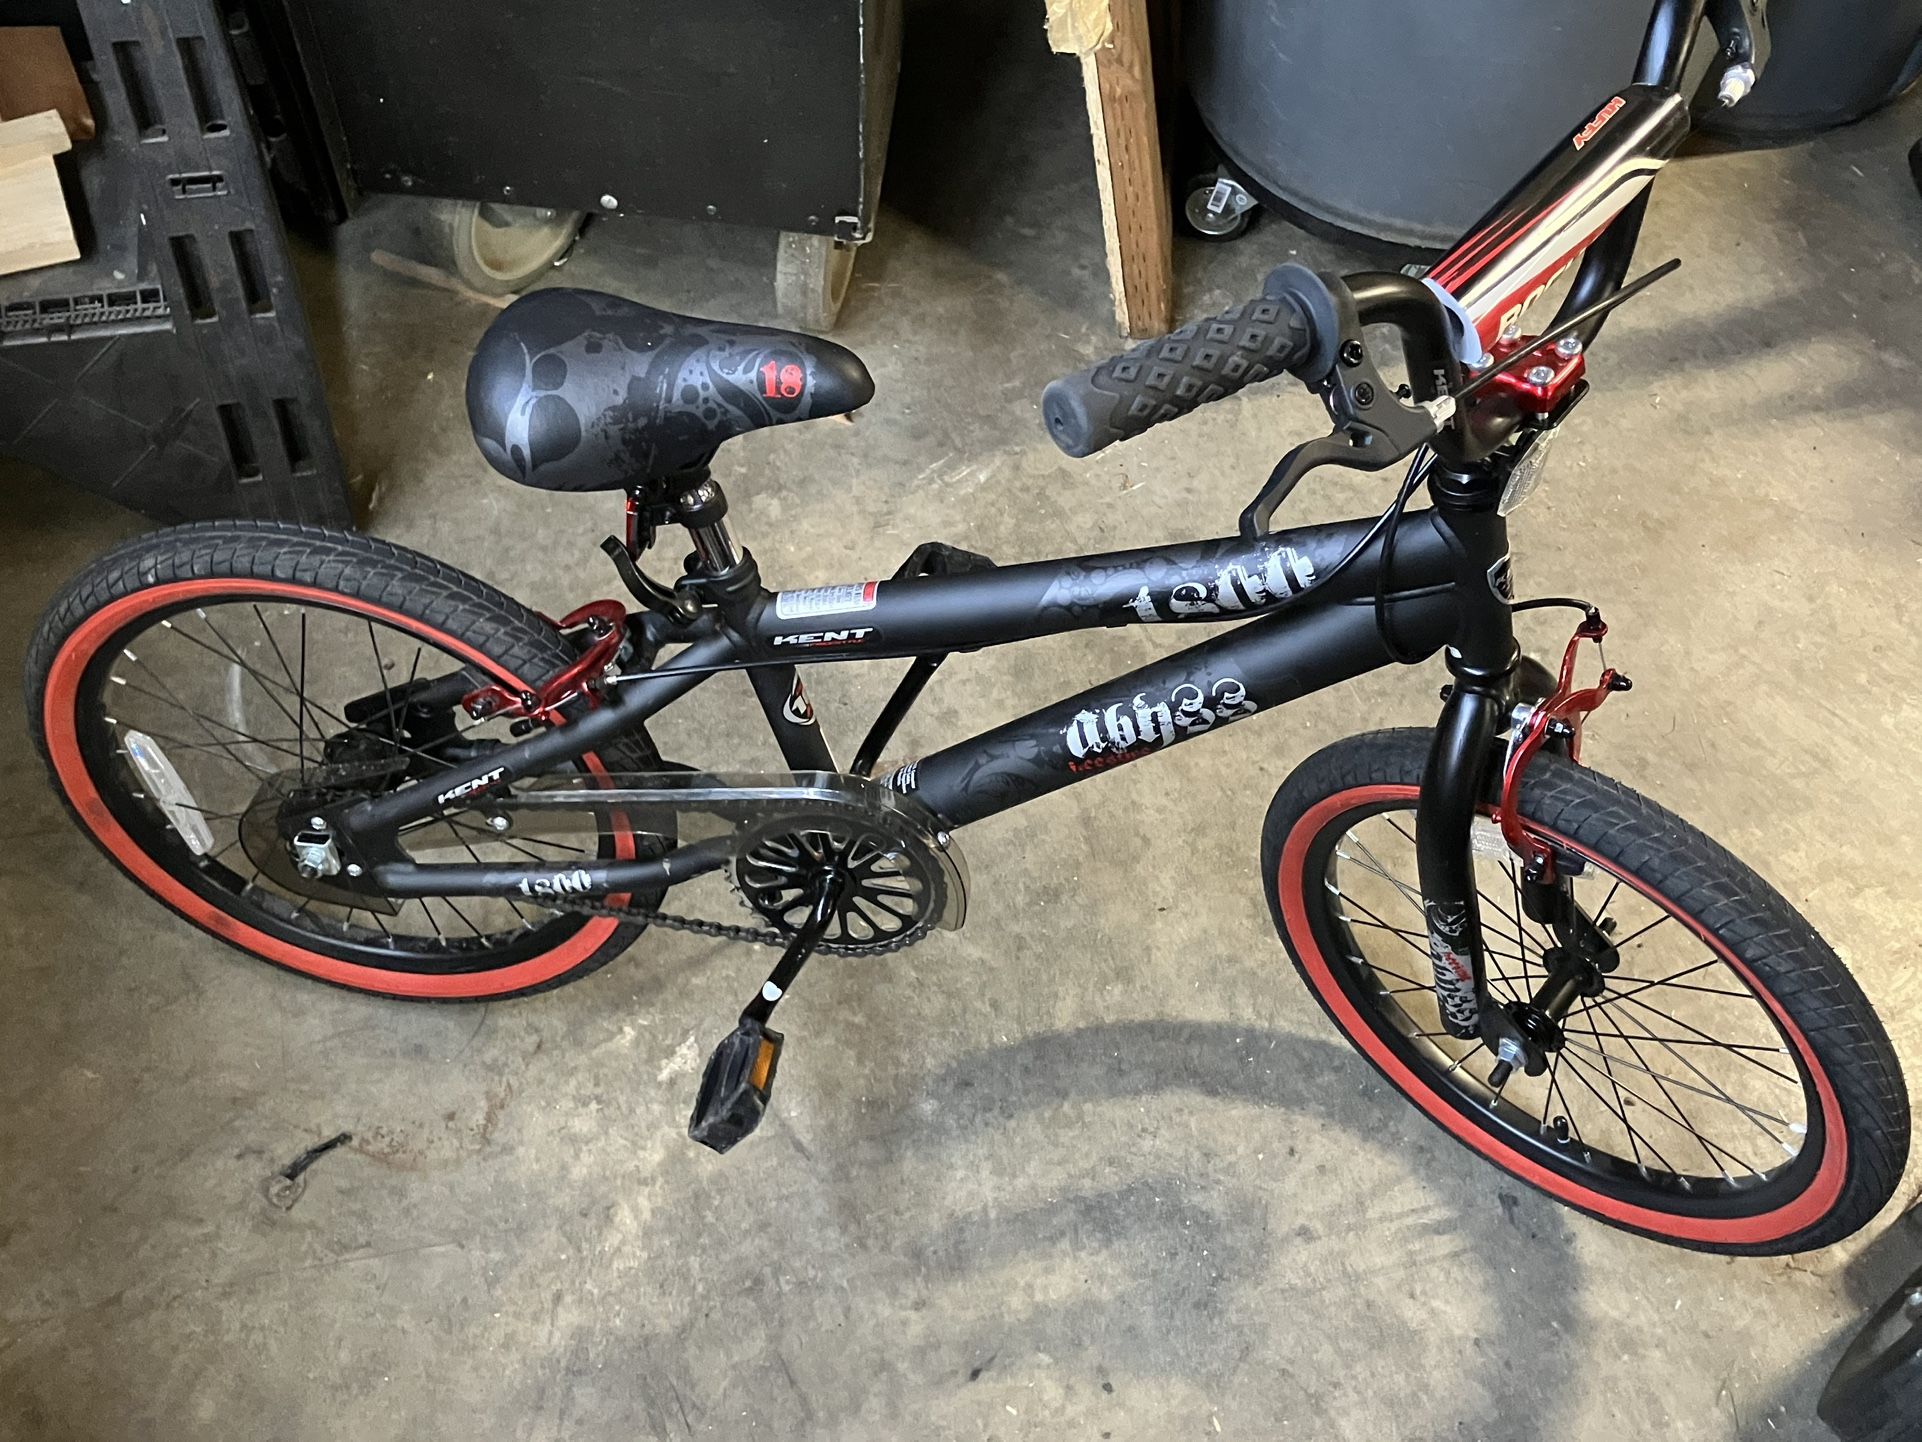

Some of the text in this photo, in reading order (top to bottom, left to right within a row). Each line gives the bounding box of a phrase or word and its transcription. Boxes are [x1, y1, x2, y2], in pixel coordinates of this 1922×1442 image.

[1572, 96, 1626, 151] HUFFY
[760, 360, 803, 398] 18
[1433, 368, 1456, 430] KET
[773, 627, 874, 646] KENT
[437, 766, 505, 804] KENT
